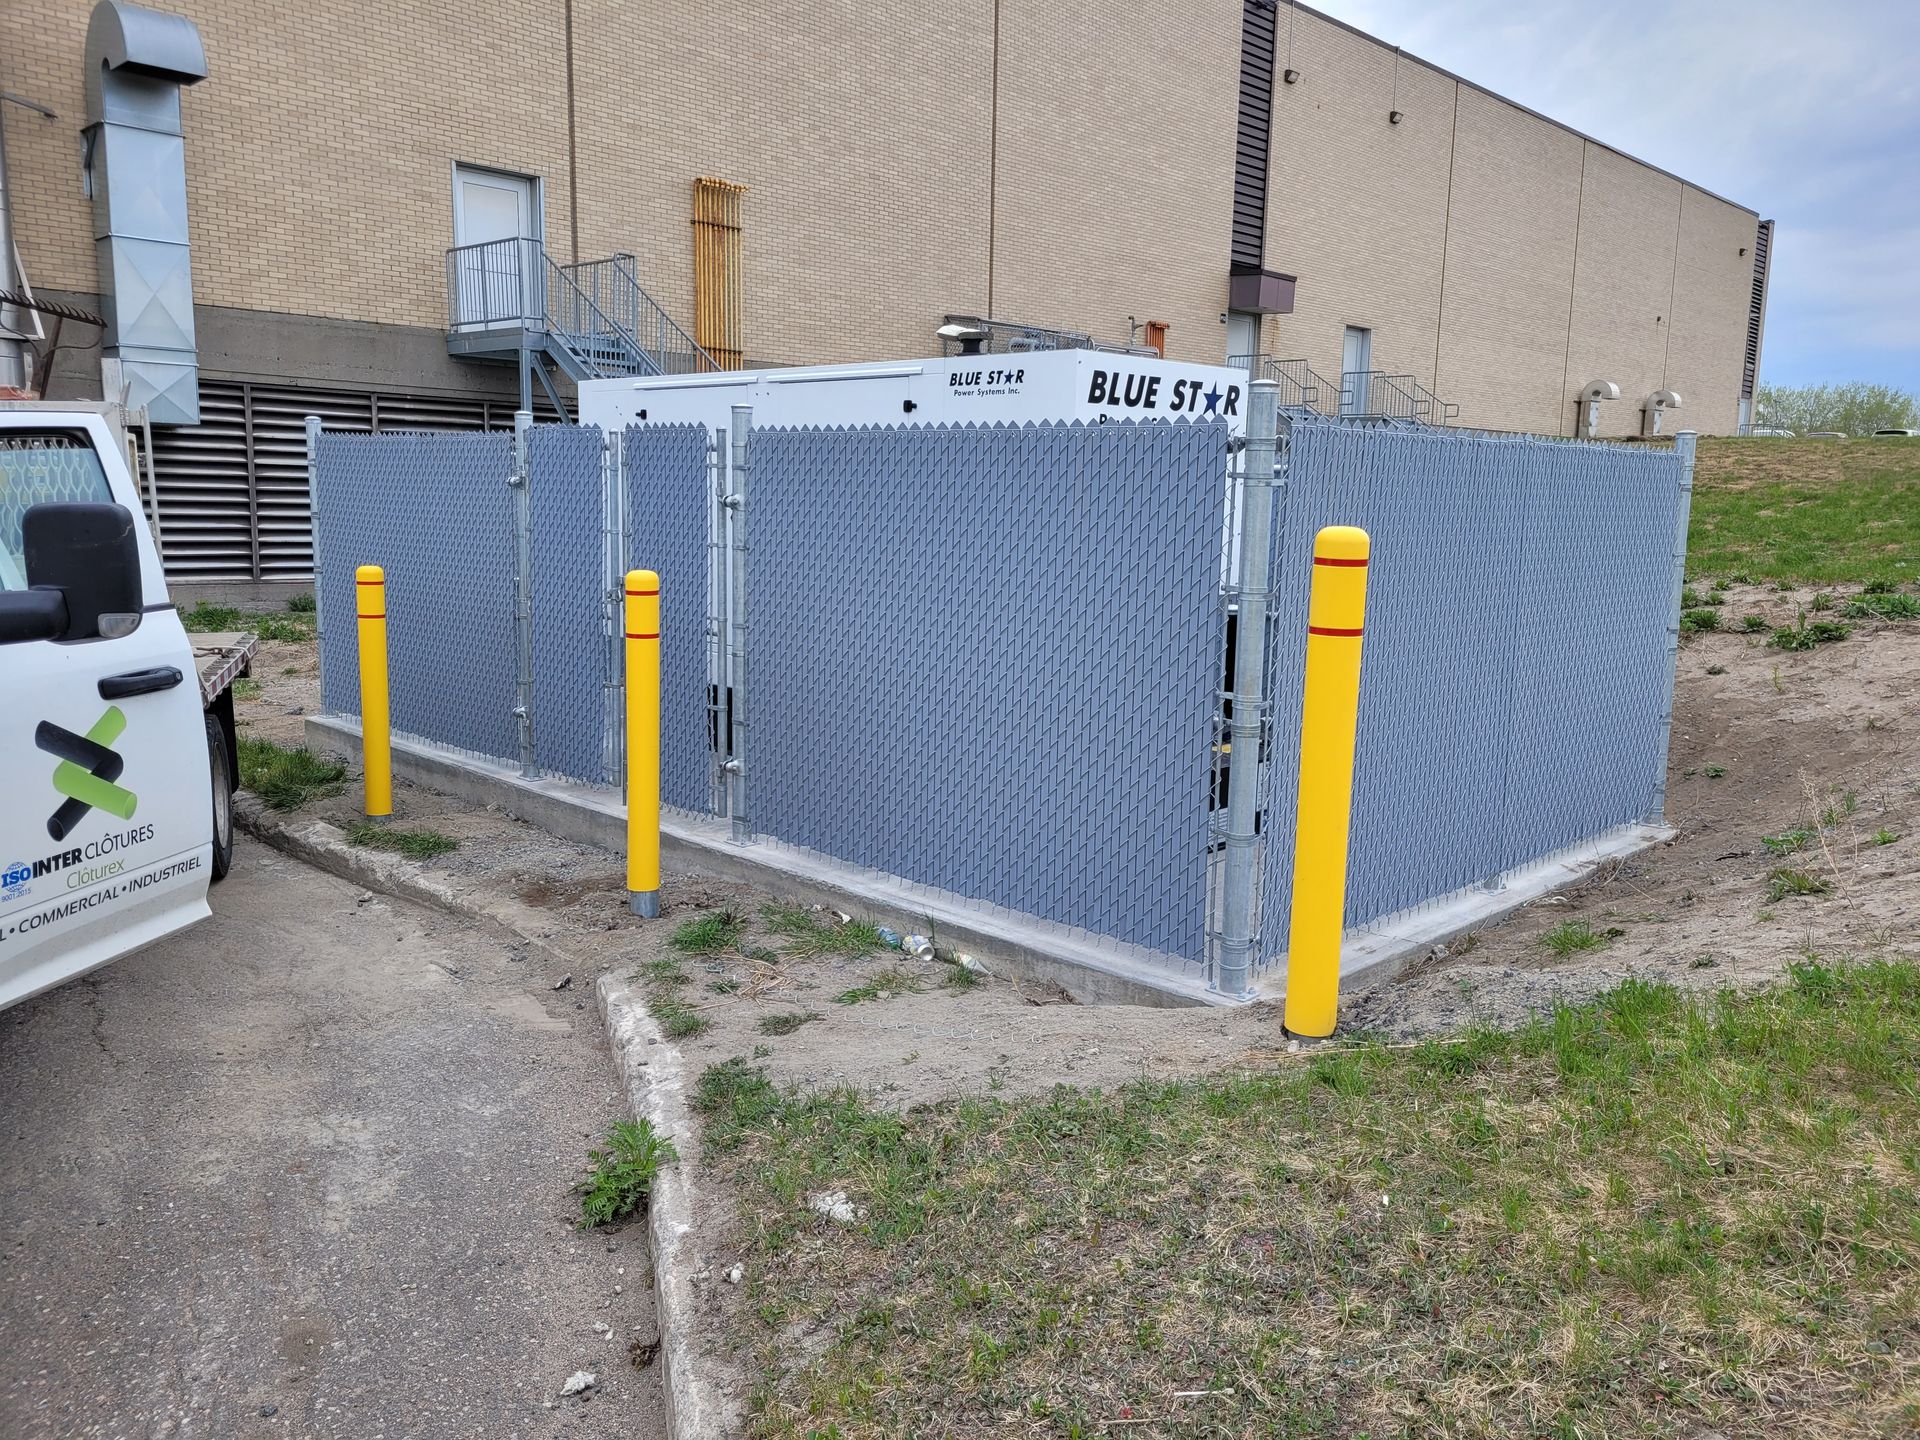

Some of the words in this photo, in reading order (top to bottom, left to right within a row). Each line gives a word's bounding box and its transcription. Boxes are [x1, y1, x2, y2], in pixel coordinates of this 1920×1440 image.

[949, 371, 982, 386] BLUE
[1088, 370, 1161, 409] BLUE
[954, 389, 975, 397] Power
[977, 388, 1006, 397] Systems
[1008, 387, 1020, 395] Inc.
[1, 867, 31, 888] ISO
[67, 858, 125, 889] Clôturex
[19, 886, 119, 933] COMMERCIAL
[129, 856, 202, 893] INDUSTRIEL
